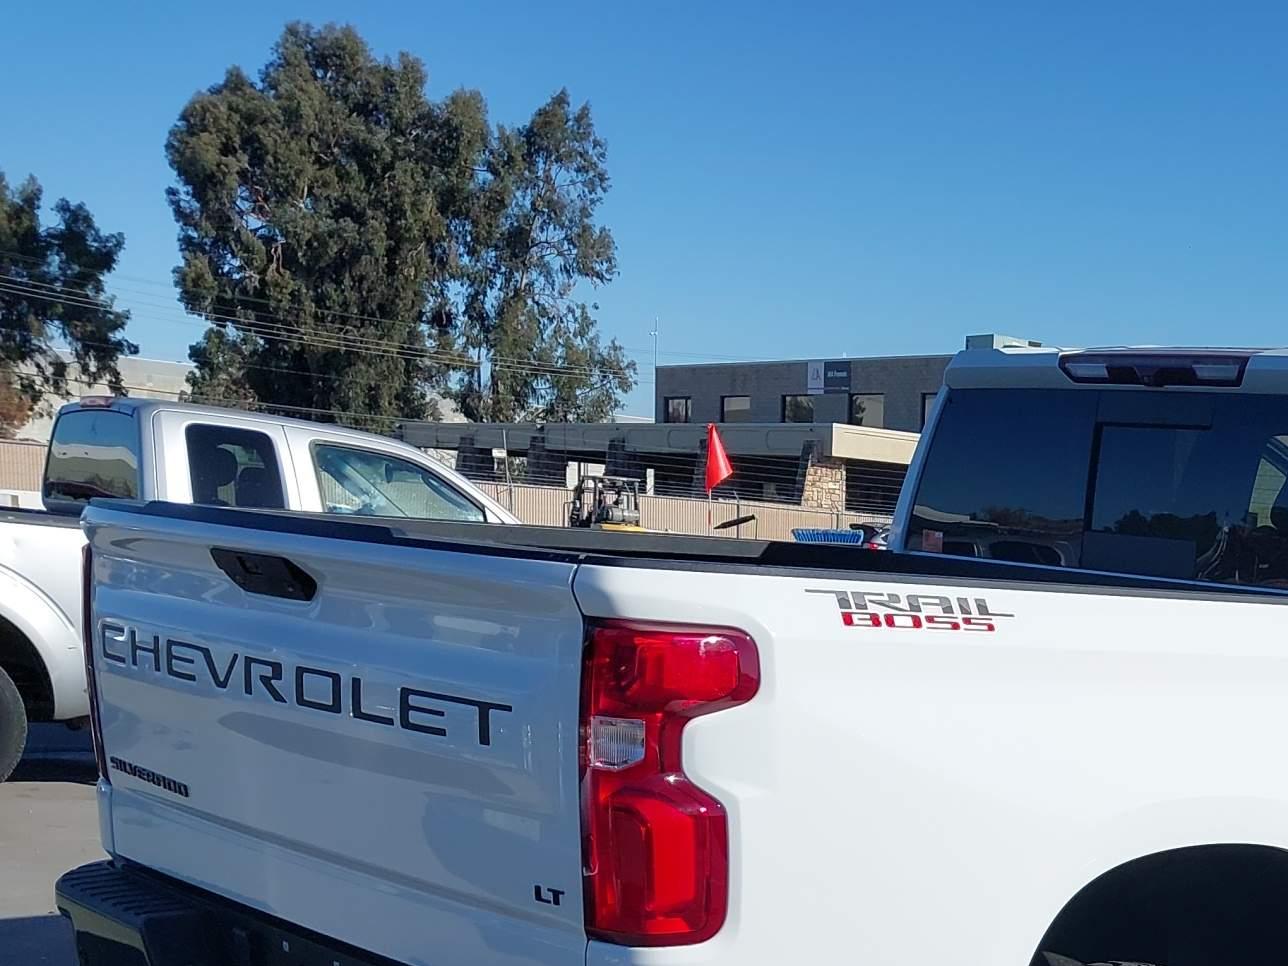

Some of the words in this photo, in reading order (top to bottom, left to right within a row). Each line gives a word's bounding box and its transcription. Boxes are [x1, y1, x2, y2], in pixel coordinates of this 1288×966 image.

[805, 588, 1015, 617] TRAIL
[840, 612, 995, 632] BOSS
[101, 622, 512, 746] CHEVROLET
[110, 755, 190, 798] SILVERADO
[534, 884, 565, 906] LT
